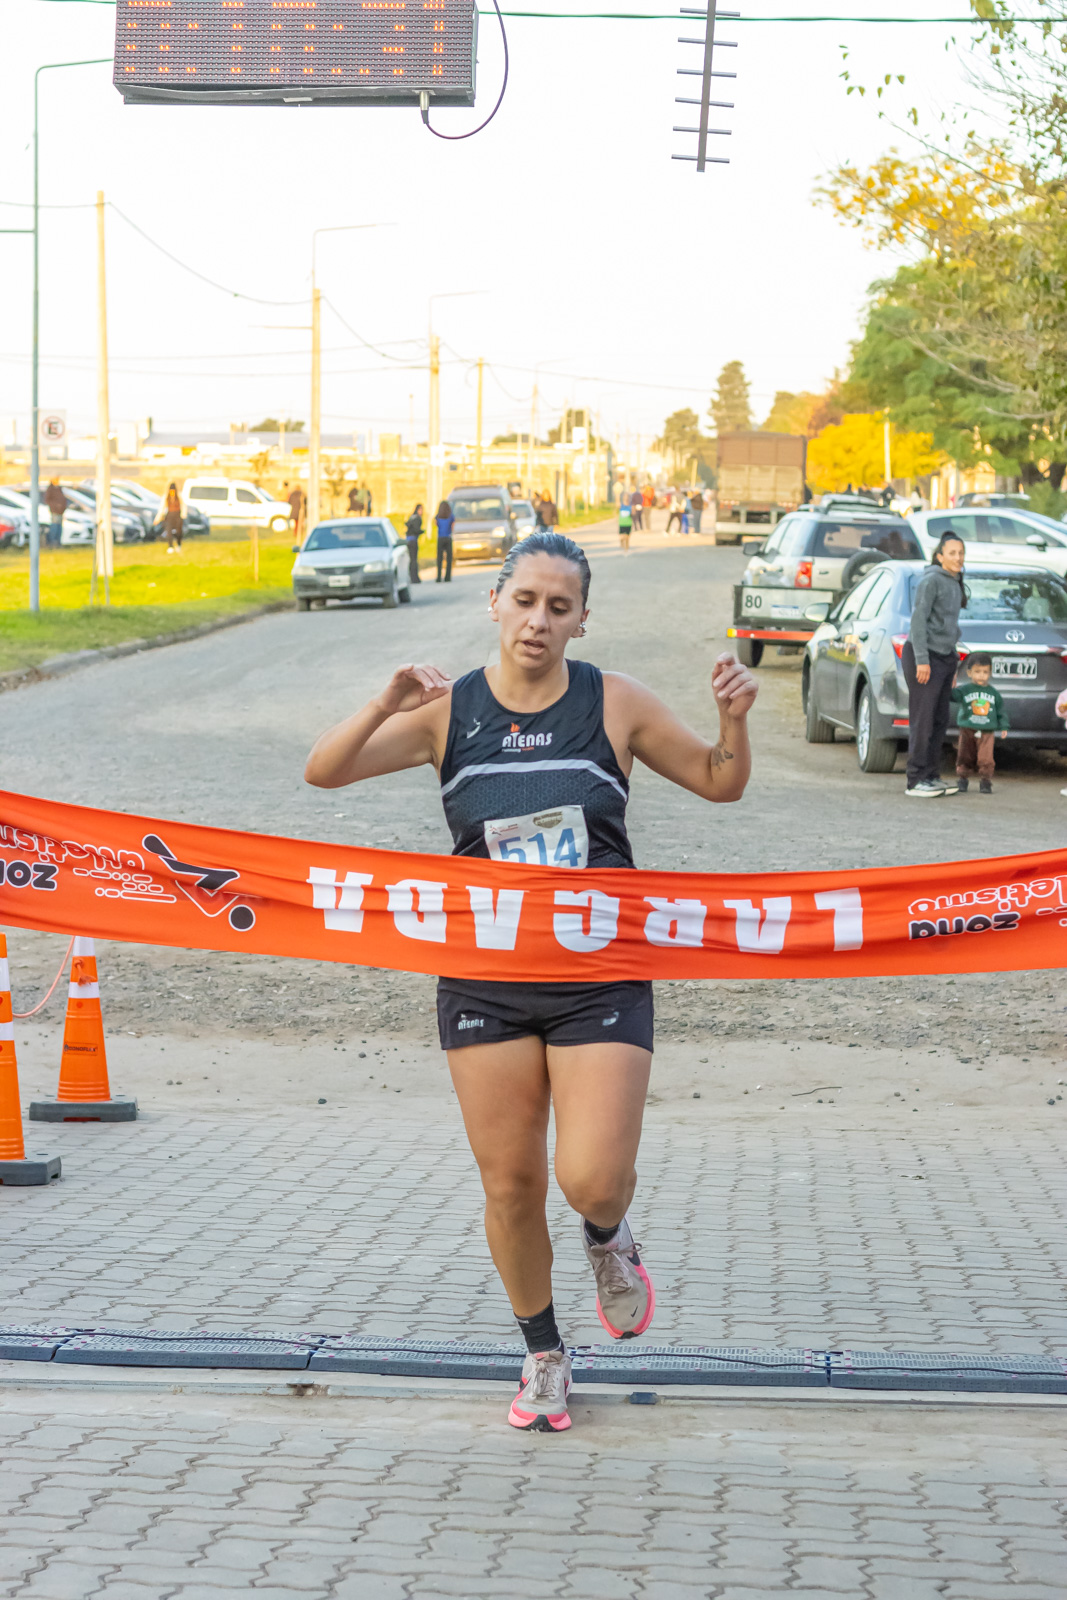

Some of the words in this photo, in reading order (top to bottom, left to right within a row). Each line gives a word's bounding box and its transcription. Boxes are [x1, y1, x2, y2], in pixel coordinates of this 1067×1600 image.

[745, 594, 762, 609] 80
[501, 731, 553, 748] ATENAS
[497, 827, 582, 868] 514
[306, 866, 864, 954] LARGADA
[908, 911, 1021, 941] zona
